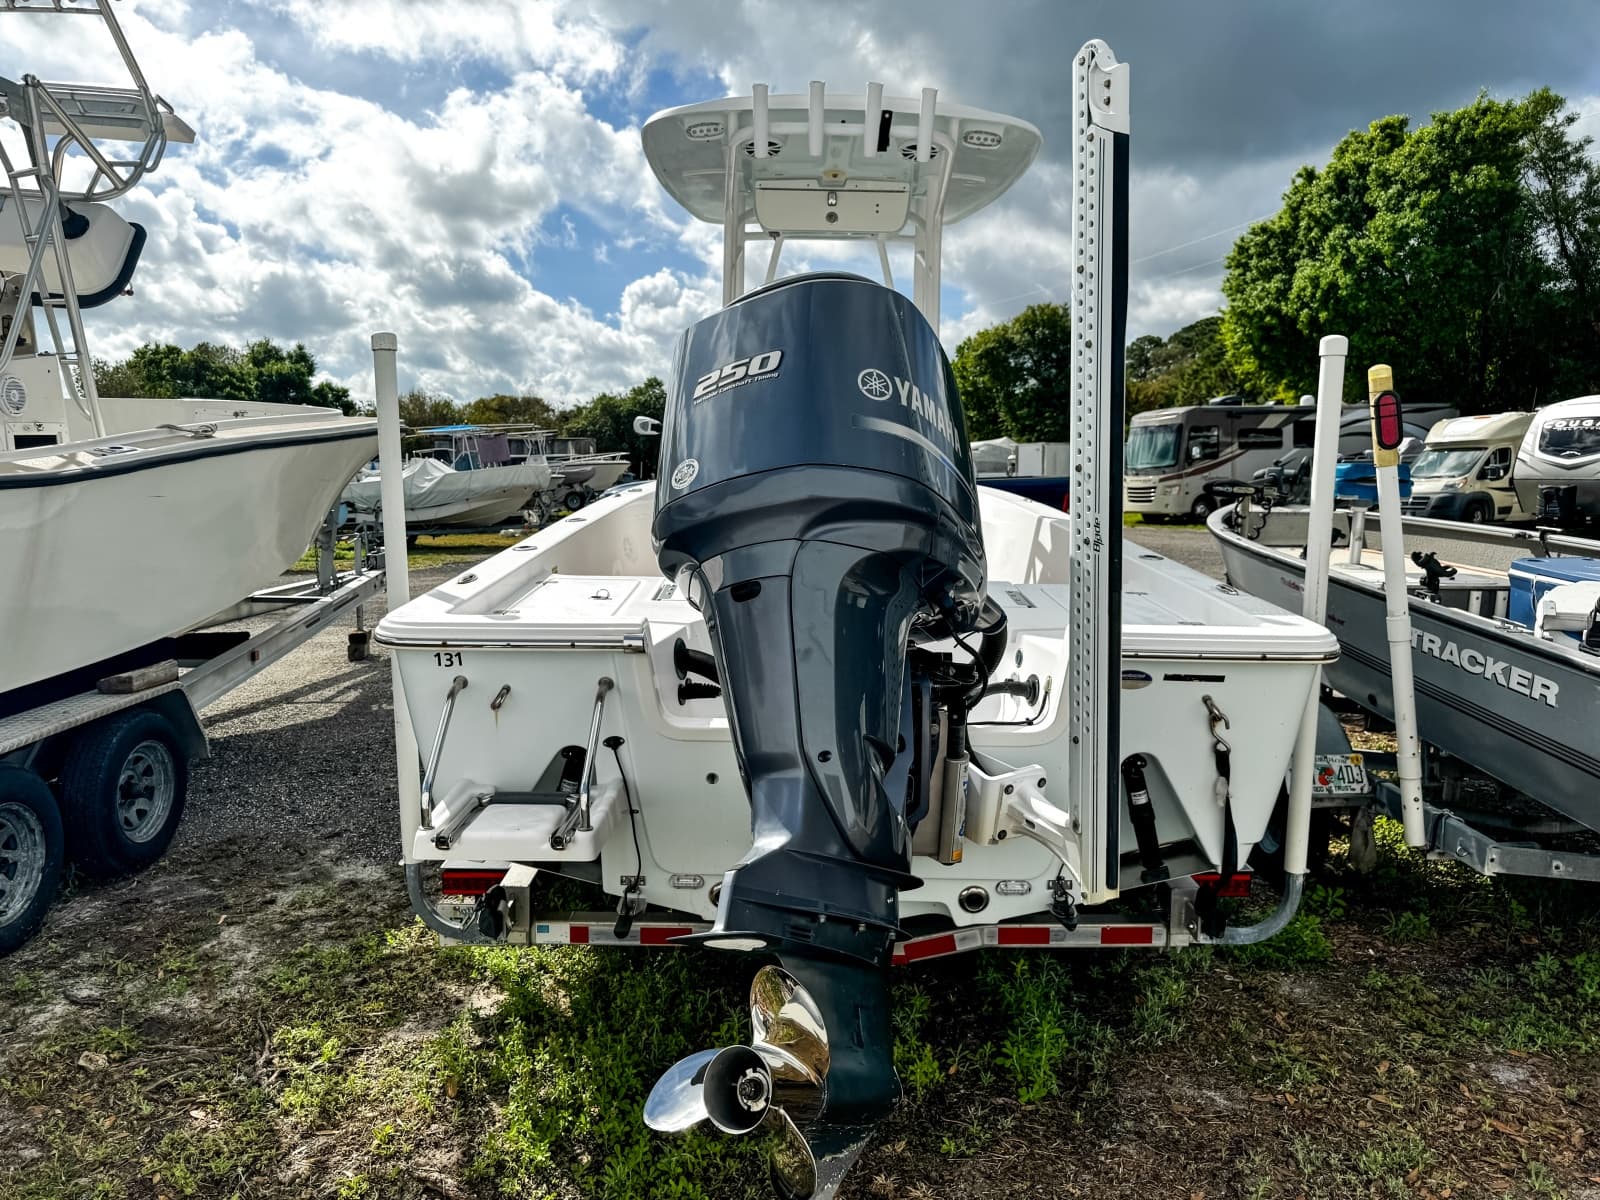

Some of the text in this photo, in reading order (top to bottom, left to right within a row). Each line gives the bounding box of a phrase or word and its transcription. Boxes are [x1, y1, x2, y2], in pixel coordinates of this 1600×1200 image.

[693, 350, 783, 400] 250
[894, 376, 962, 457] YAMAHA
[433, 651, 464, 668] 131
[1410, 626, 1560, 708] TRACKER
